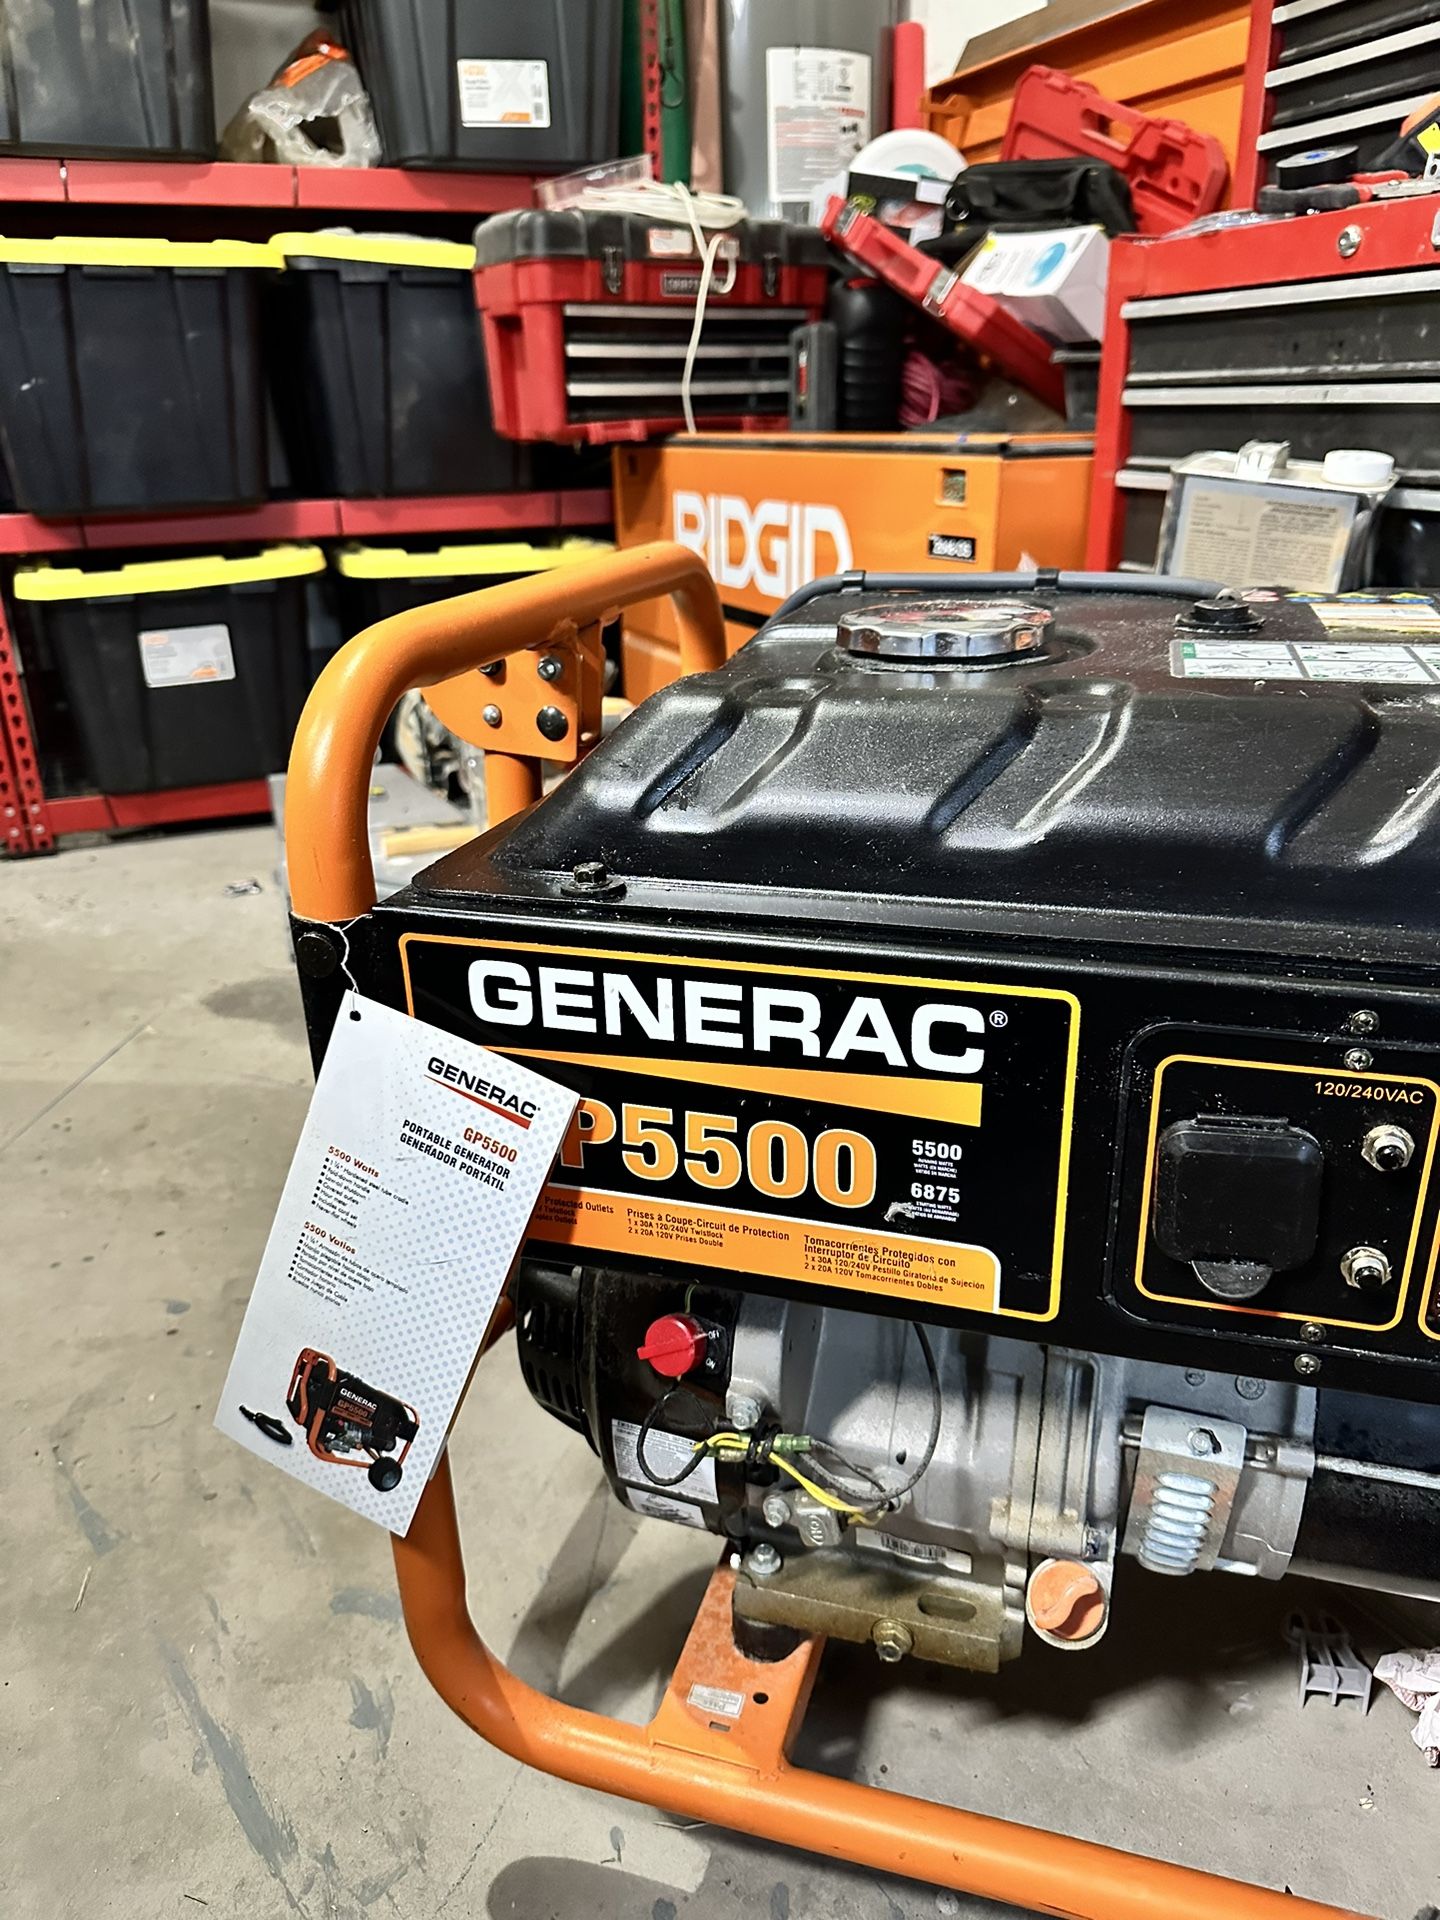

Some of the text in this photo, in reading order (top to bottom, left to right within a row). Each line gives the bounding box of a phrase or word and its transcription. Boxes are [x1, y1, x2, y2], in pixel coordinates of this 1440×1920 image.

[673, 490, 853, 599] RIDGID
[427, 1057, 537, 1119] GENERAC
[1314, 1081, 1424, 1105] 120/240VAC
[403, 1119, 511, 1179] PORTABLE GENERATOR
[463, 1128, 517, 1163] GP5500
[559, 1097, 877, 1209] P5500
[912, 1140, 962, 1160] 5500
[327, 1146, 380, 1177] 5500 Watts
[400, 1133, 505, 1191] GENERADOR PORTÁTIL
[586, 1201, 614, 1214] Outlets
[911, 1183, 960, 1204] 6875
[303, 1221, 357, 1254] 5500 Vatios
[627, 1208, 789, 1241] Prises à Coupe-Circuit de Protection
[640, 1229, 654, 1237] 20A
[656, 1231, 673, 1240] 120V
[675, 1233, 697, 1243] Prises
[699, 1237, 723, 1247] Double
[656, 1222, 688, 1234] 120/240V
[691, 1227, 723, 1239] Twistlock
[804, 1235, 956, 1267] Tomacorrientes Protegidos con
[804, 1244, 910, 1269] Interruptor de Circuito
[817, 1265, 832, 1273] 20A
[835, 1267, 853, 1277] 120V
[856, 1271, 914, 1288] Tomacorrientes
[917, 1281, 943, 1292] Dobles
[835, 1258, 871, 1271] 120/240V
[873, 1265, 901, 1277] Pestillo
[939, 1275, 949, 1284] de
[340, 1388, 377, 1410] GENERAC
